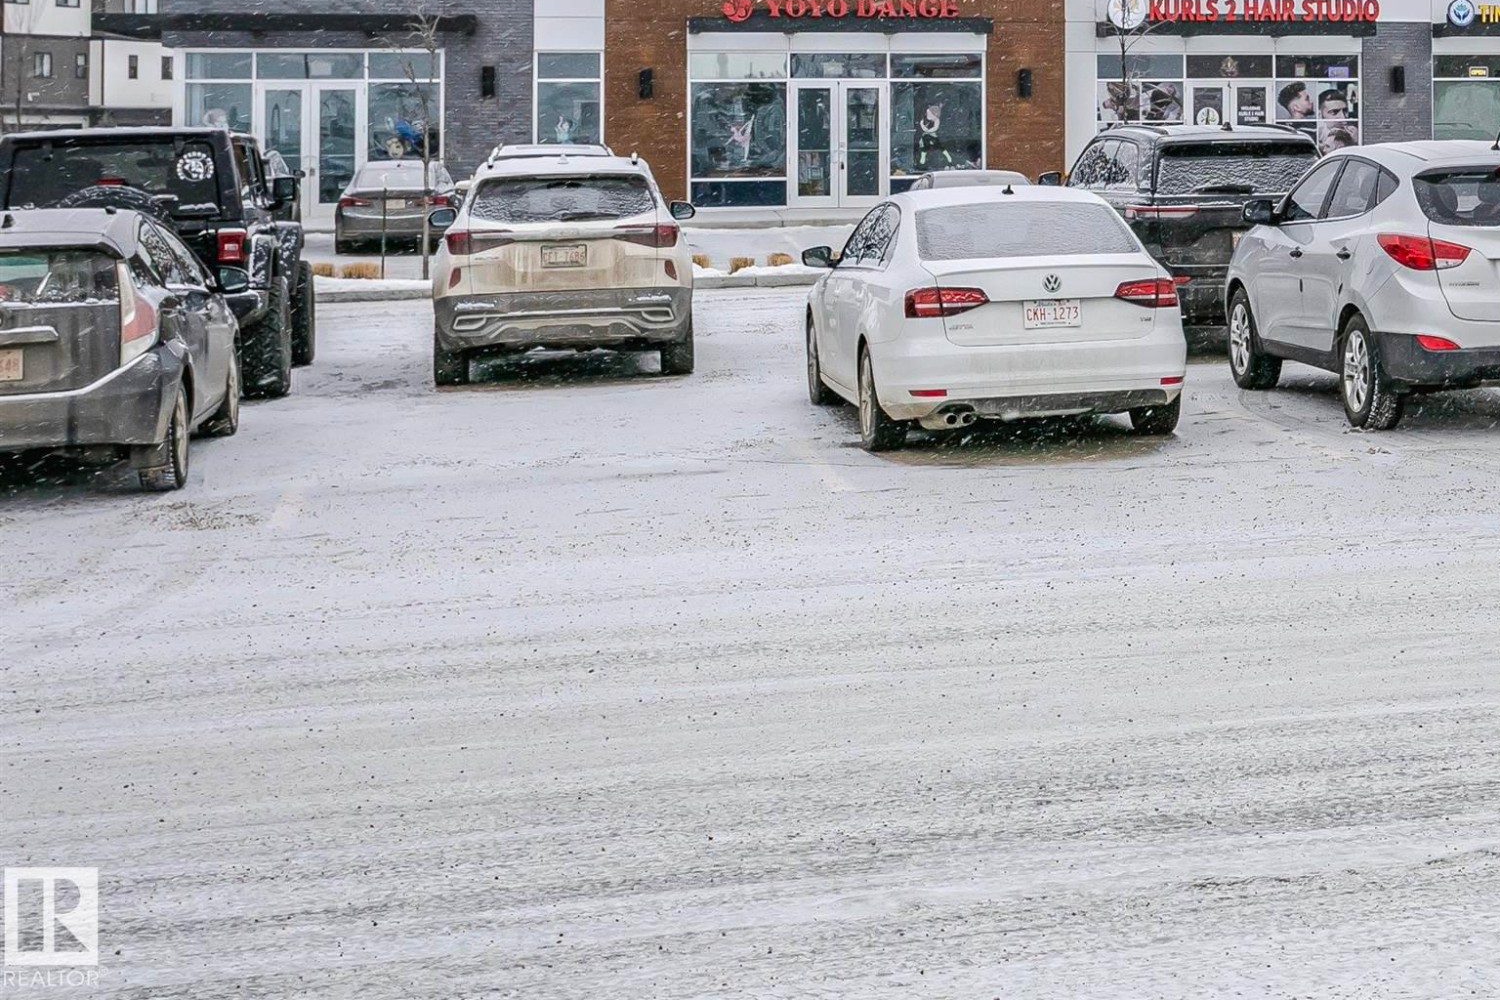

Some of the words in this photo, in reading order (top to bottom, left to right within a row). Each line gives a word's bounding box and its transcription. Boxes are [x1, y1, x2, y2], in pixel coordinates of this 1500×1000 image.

[1225, 0, 1236, 21] 2
[1243, 0, 1295, 22] HAIR
[1026, 306, 1079, 321] CKH-1273
